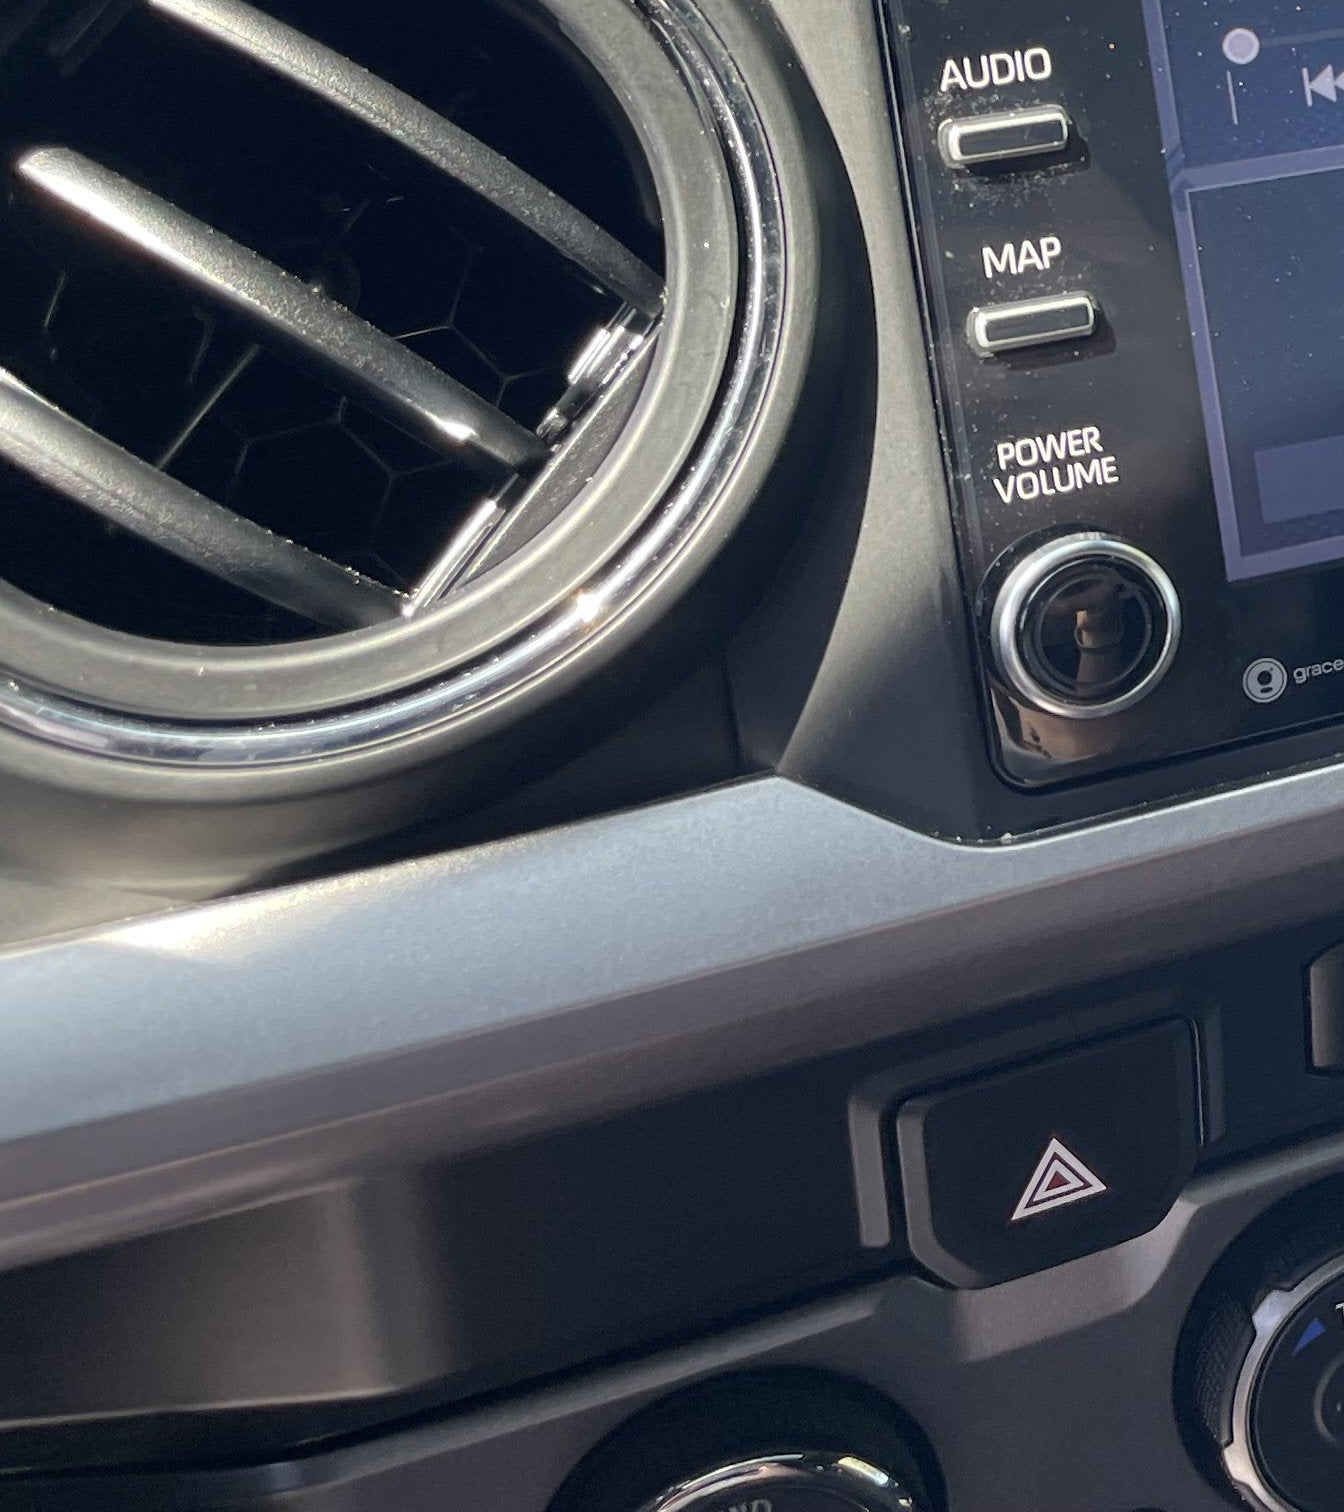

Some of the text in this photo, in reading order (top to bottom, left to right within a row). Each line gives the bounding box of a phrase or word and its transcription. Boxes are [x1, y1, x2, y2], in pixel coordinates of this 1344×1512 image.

[939, 46, 1053, 92] AUDIO
[981, 236, 1063, 279] MAP
[996, 425, 1105, 471] POWER
[993, 455, 1120, 506] VOLUME
